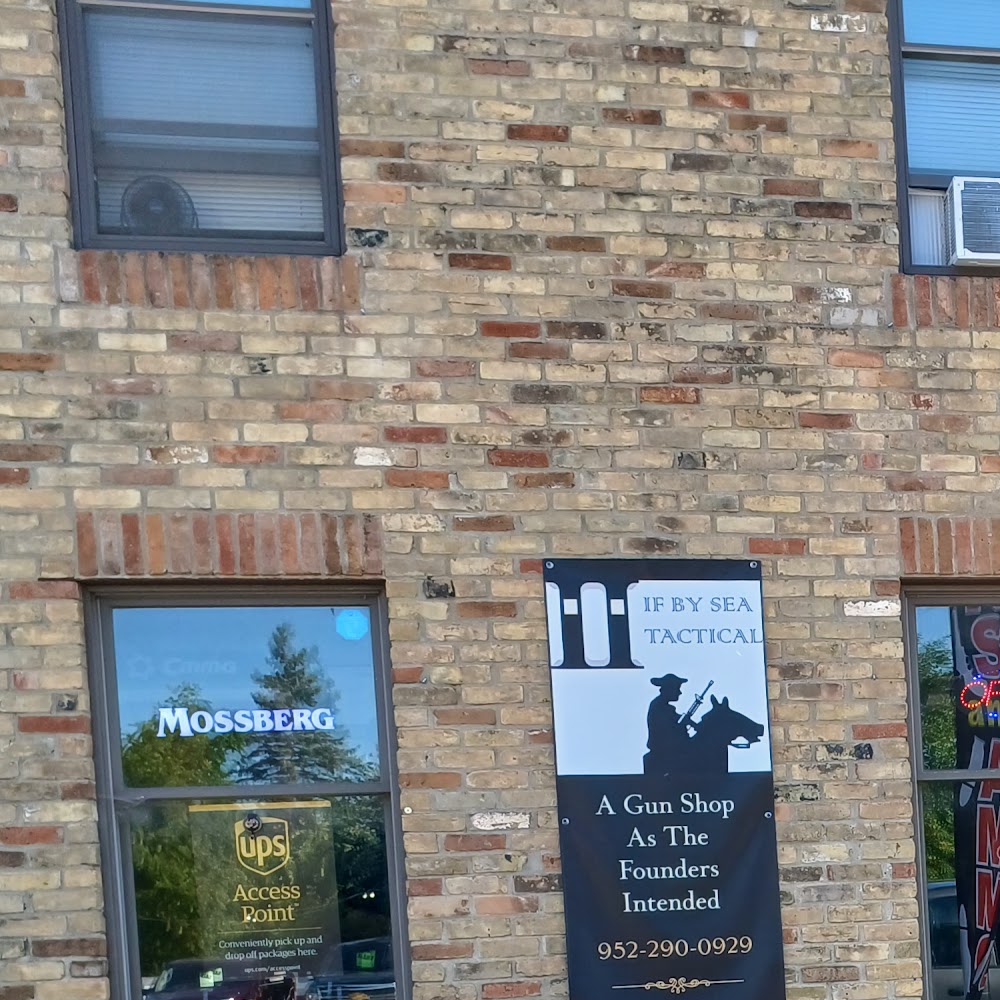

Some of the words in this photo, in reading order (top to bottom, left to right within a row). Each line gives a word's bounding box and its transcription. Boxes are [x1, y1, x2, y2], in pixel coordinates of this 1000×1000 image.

[643, 596, 664, 612] IF
[671, 596, 703, 612] BY
[710, 596, 753, 612] SEA
[643, 628, 764, 644] TACTICAL
[157, 707, 335, 738] MOSSBERG
[595, 795, 616, 816] A
[623, 794, 673, 815] Gun
[680, 793, 735, 818] Shop
[626, 827, 657, 847] As
[662, 825, 709, 846] The
[239, 835, 286, 867] ups
[619, 858, 720, 880] Founders
[233, 884, 301, 902] Access
[623, 890, 720, 913] Intended
[218, 937, 273, 949] Conveniently
[274, 936, 293, 947] pick
[293, 938, 305, 947] up
[306, 935, 323, 944] and
[597, 936, 753, 960] 952-290-0929
[225, 951, 245, 961] drop
[245, 950, 257, 959] off
[258, 949, 297, 960] packages
